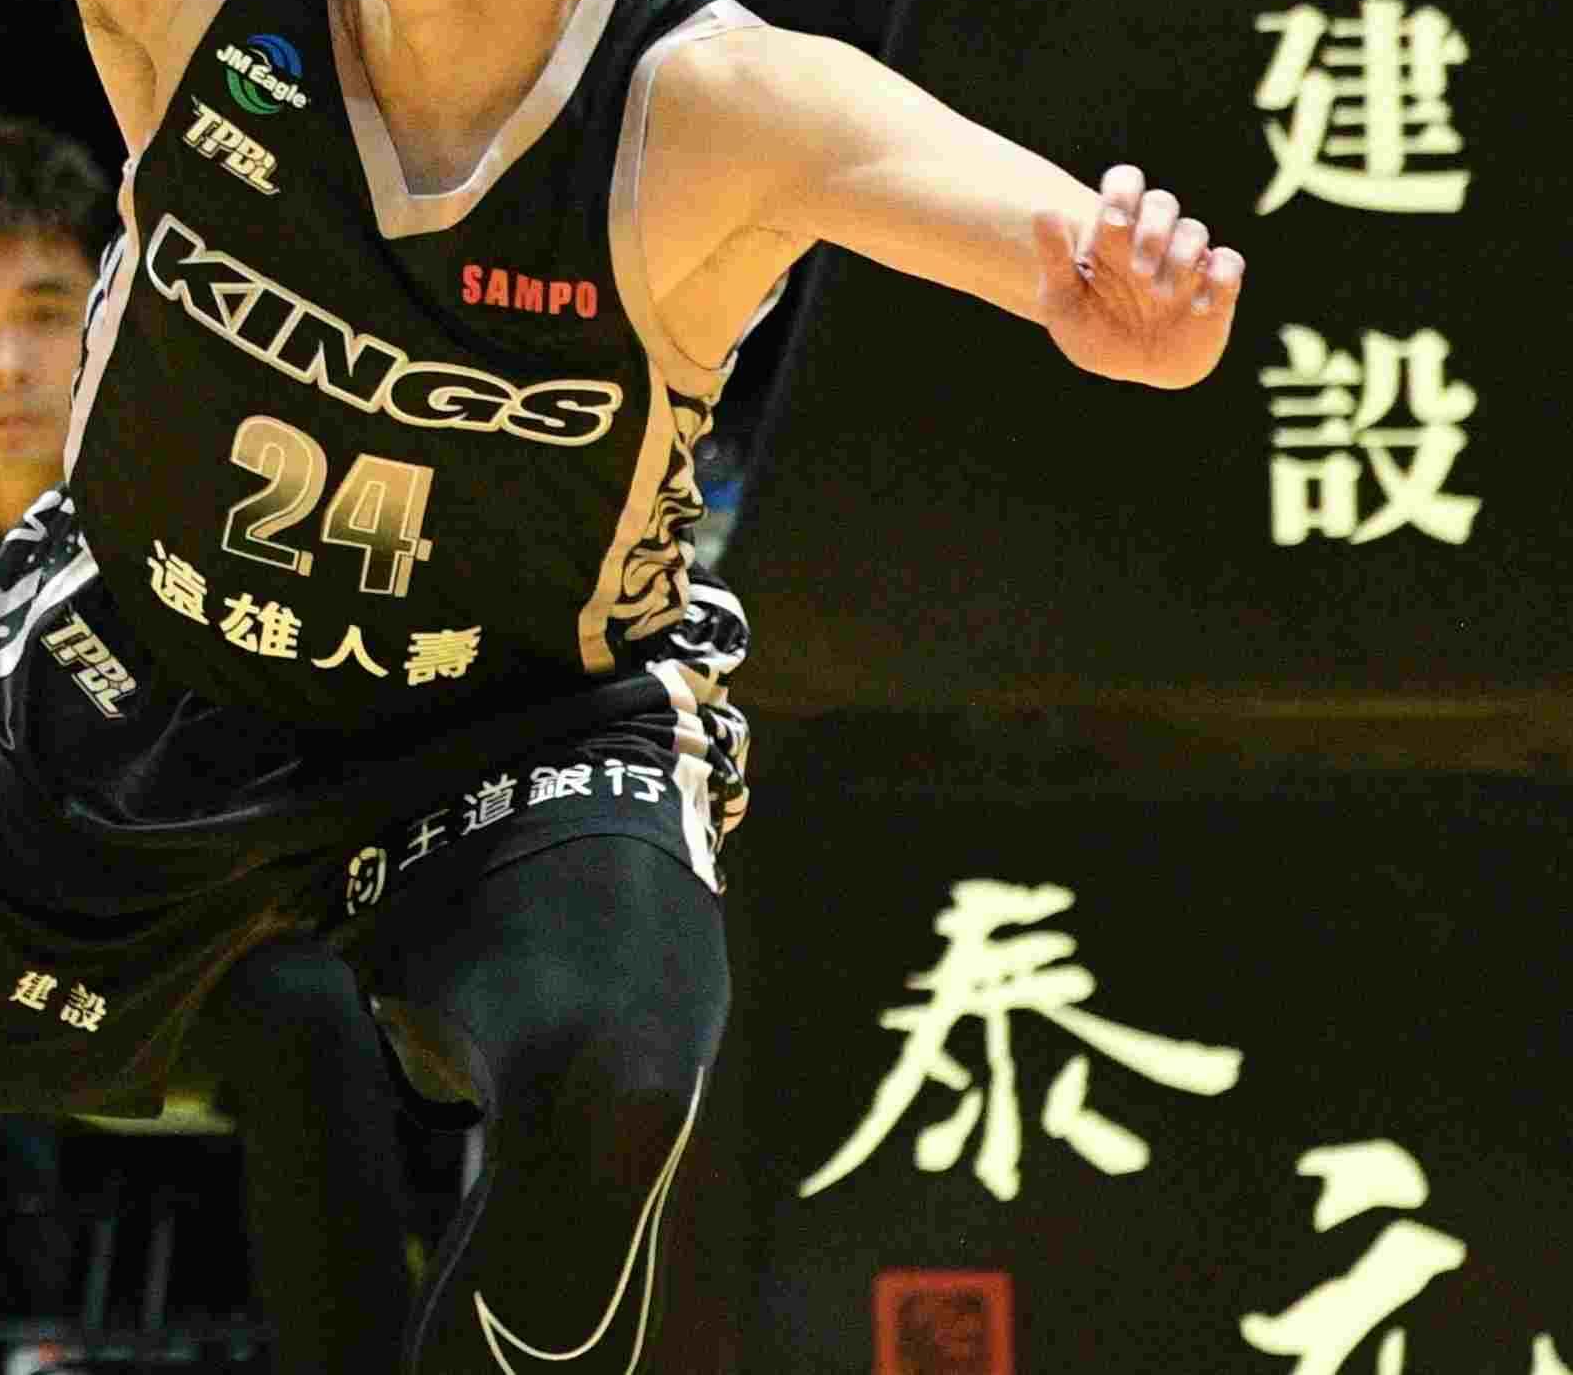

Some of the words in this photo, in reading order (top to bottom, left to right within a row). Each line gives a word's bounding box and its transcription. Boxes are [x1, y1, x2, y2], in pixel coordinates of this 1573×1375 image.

[215, 44, 253, 75] JM
[248, 63, 308, 109] Eagle
[183, 95, 281, 195] TPBL
[145, 213, 623, 446] KINGS
[462, 264, 598, 319] SAMPO
[221, 414, 435, 598] 24
[40, 610, 142, 719] TPBL
[145, 540, 482, 687] 遠雄人壽
[398, 757, 667, 872] 王道銀行
